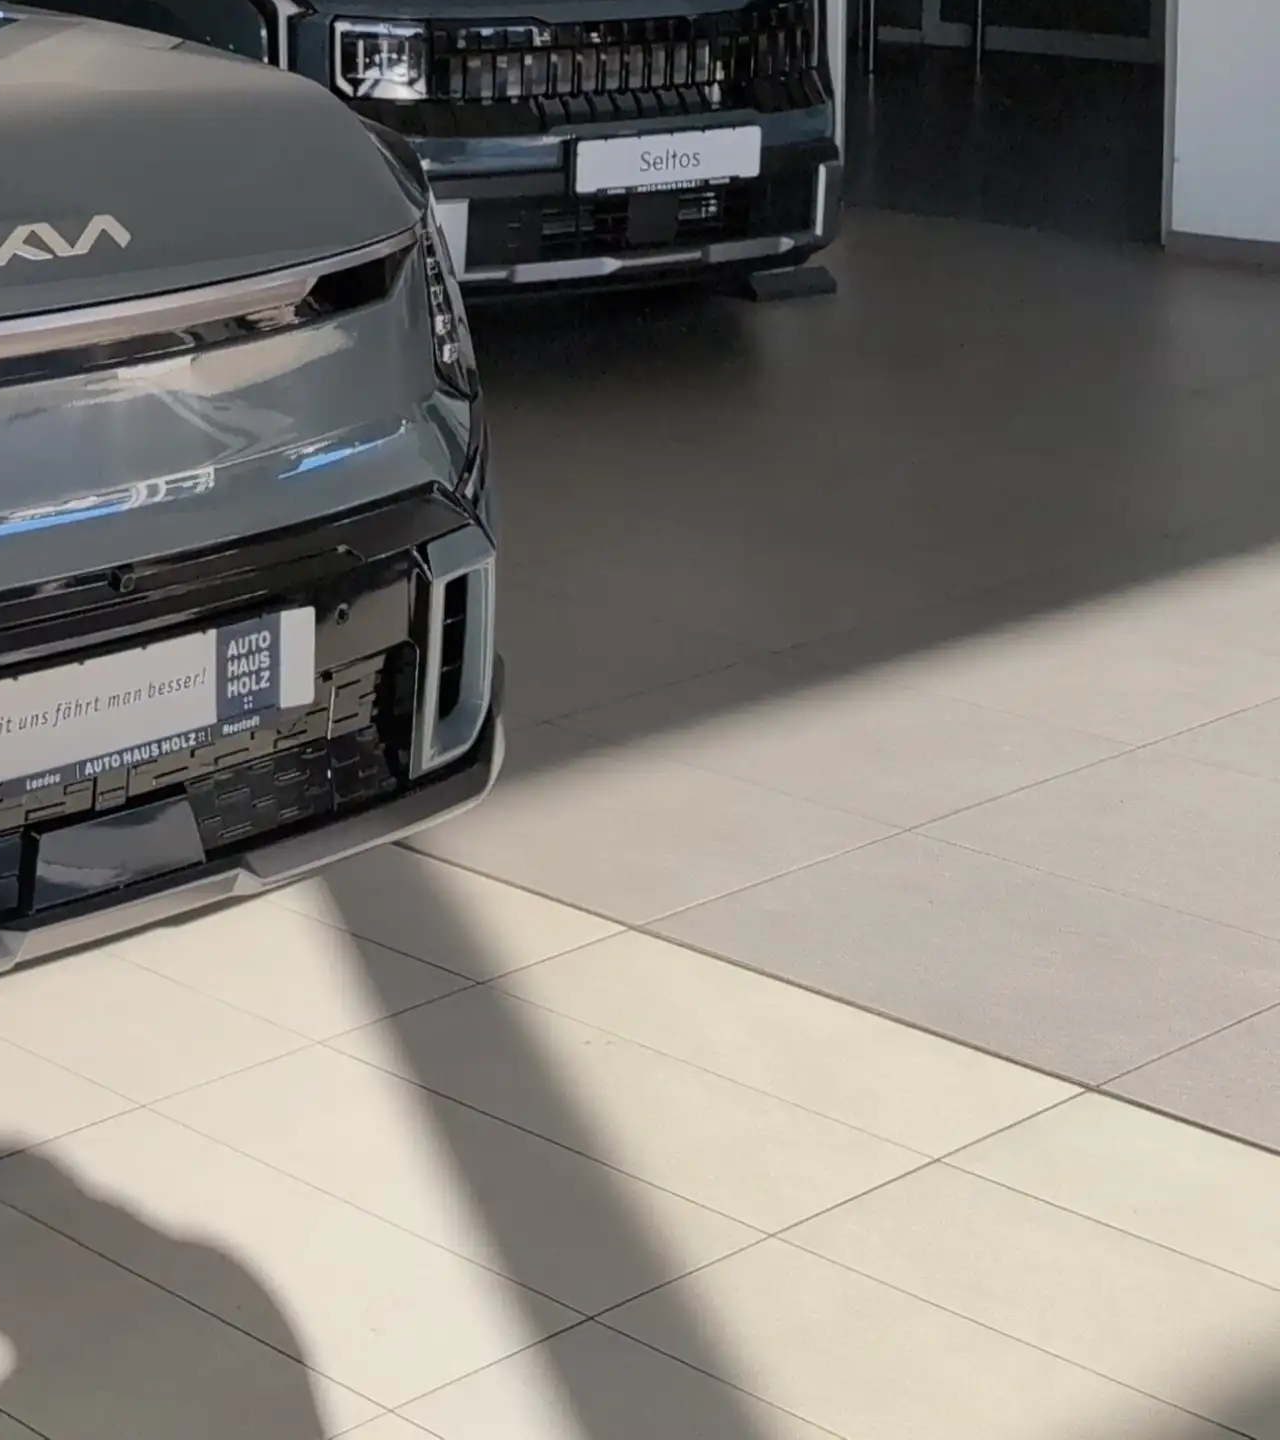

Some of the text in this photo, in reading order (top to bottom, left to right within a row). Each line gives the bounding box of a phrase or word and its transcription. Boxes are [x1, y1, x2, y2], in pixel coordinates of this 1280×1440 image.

[640, 149, 701, 172] Seltos
[227, 630, 271, 658] AUTO
[227, 650, 271, 678] HAUS
[18, 711, 49, 730] uns
[52, 698, 101, 728] fährt
[107, 687, 142, 710] man
[148, 666, 207, 698] besser!
[227, 670, 271, 698] HOLZ
[85, 754, 120, 776] AUTO
[123, 743, 159, 765] HAUS
[161, 732, 197, 754] HOLZ
